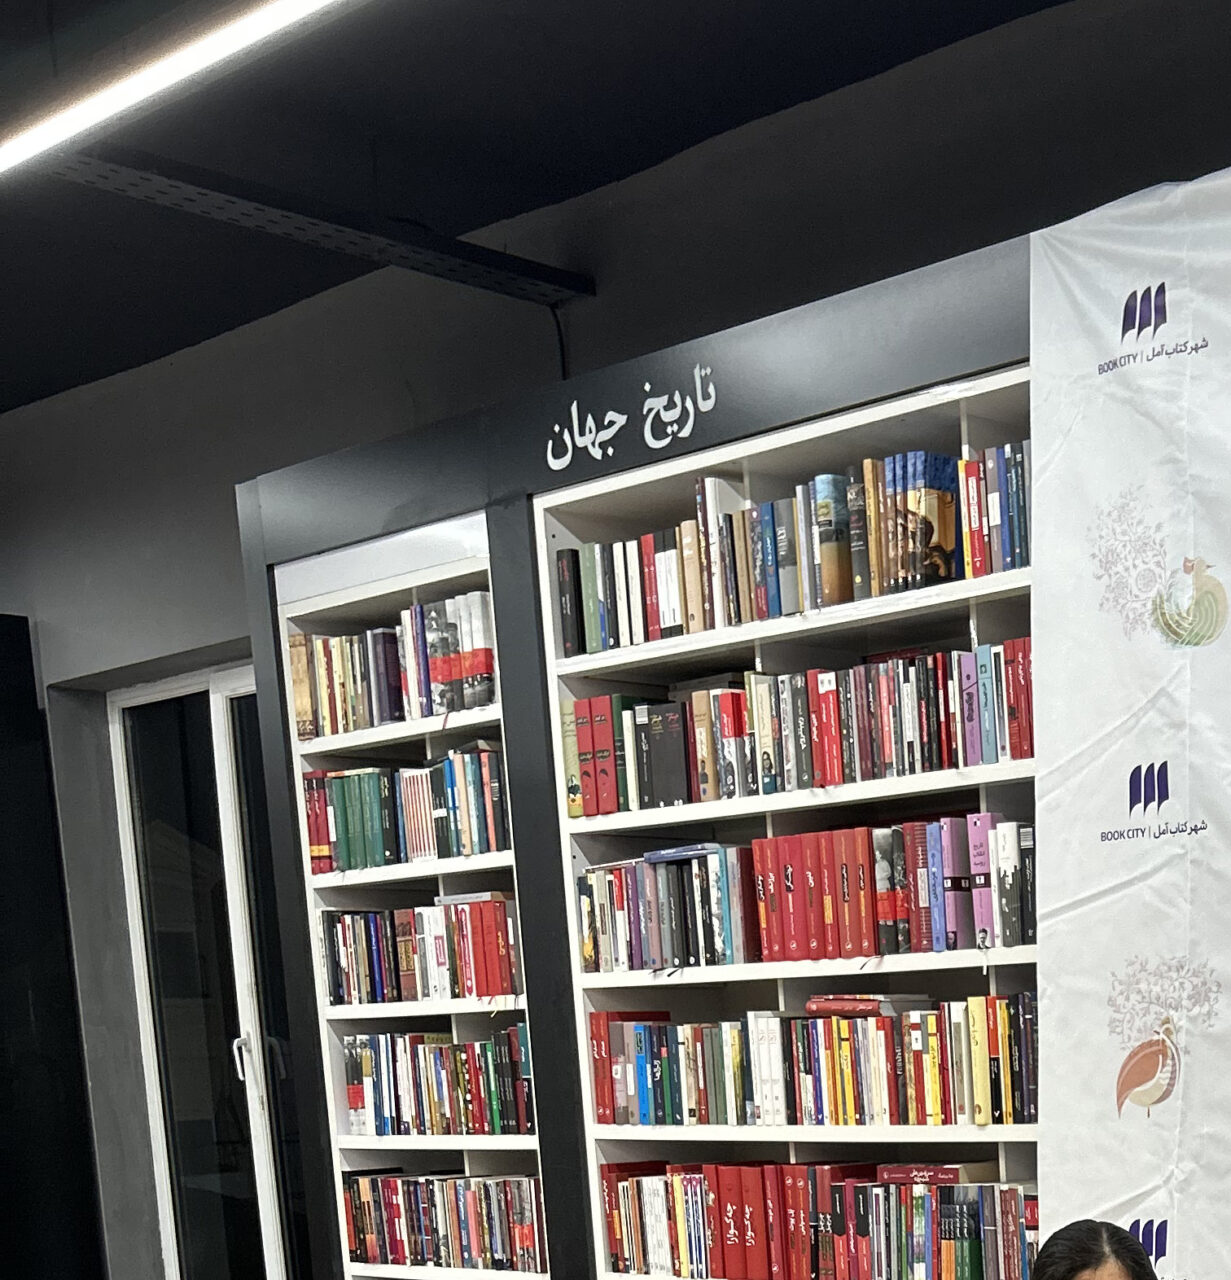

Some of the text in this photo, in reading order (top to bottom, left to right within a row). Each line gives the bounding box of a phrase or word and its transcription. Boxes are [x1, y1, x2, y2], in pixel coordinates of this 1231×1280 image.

[1146, 344, 1166, 362] آمل
[1098, 352, 1138, 376] BOOK CITY
[546, 363, 716, 471] تاریخ جهان
[1100, 827, 1147, 842] BOOK CITY
[1153, 822, 1169, 840] آمل
